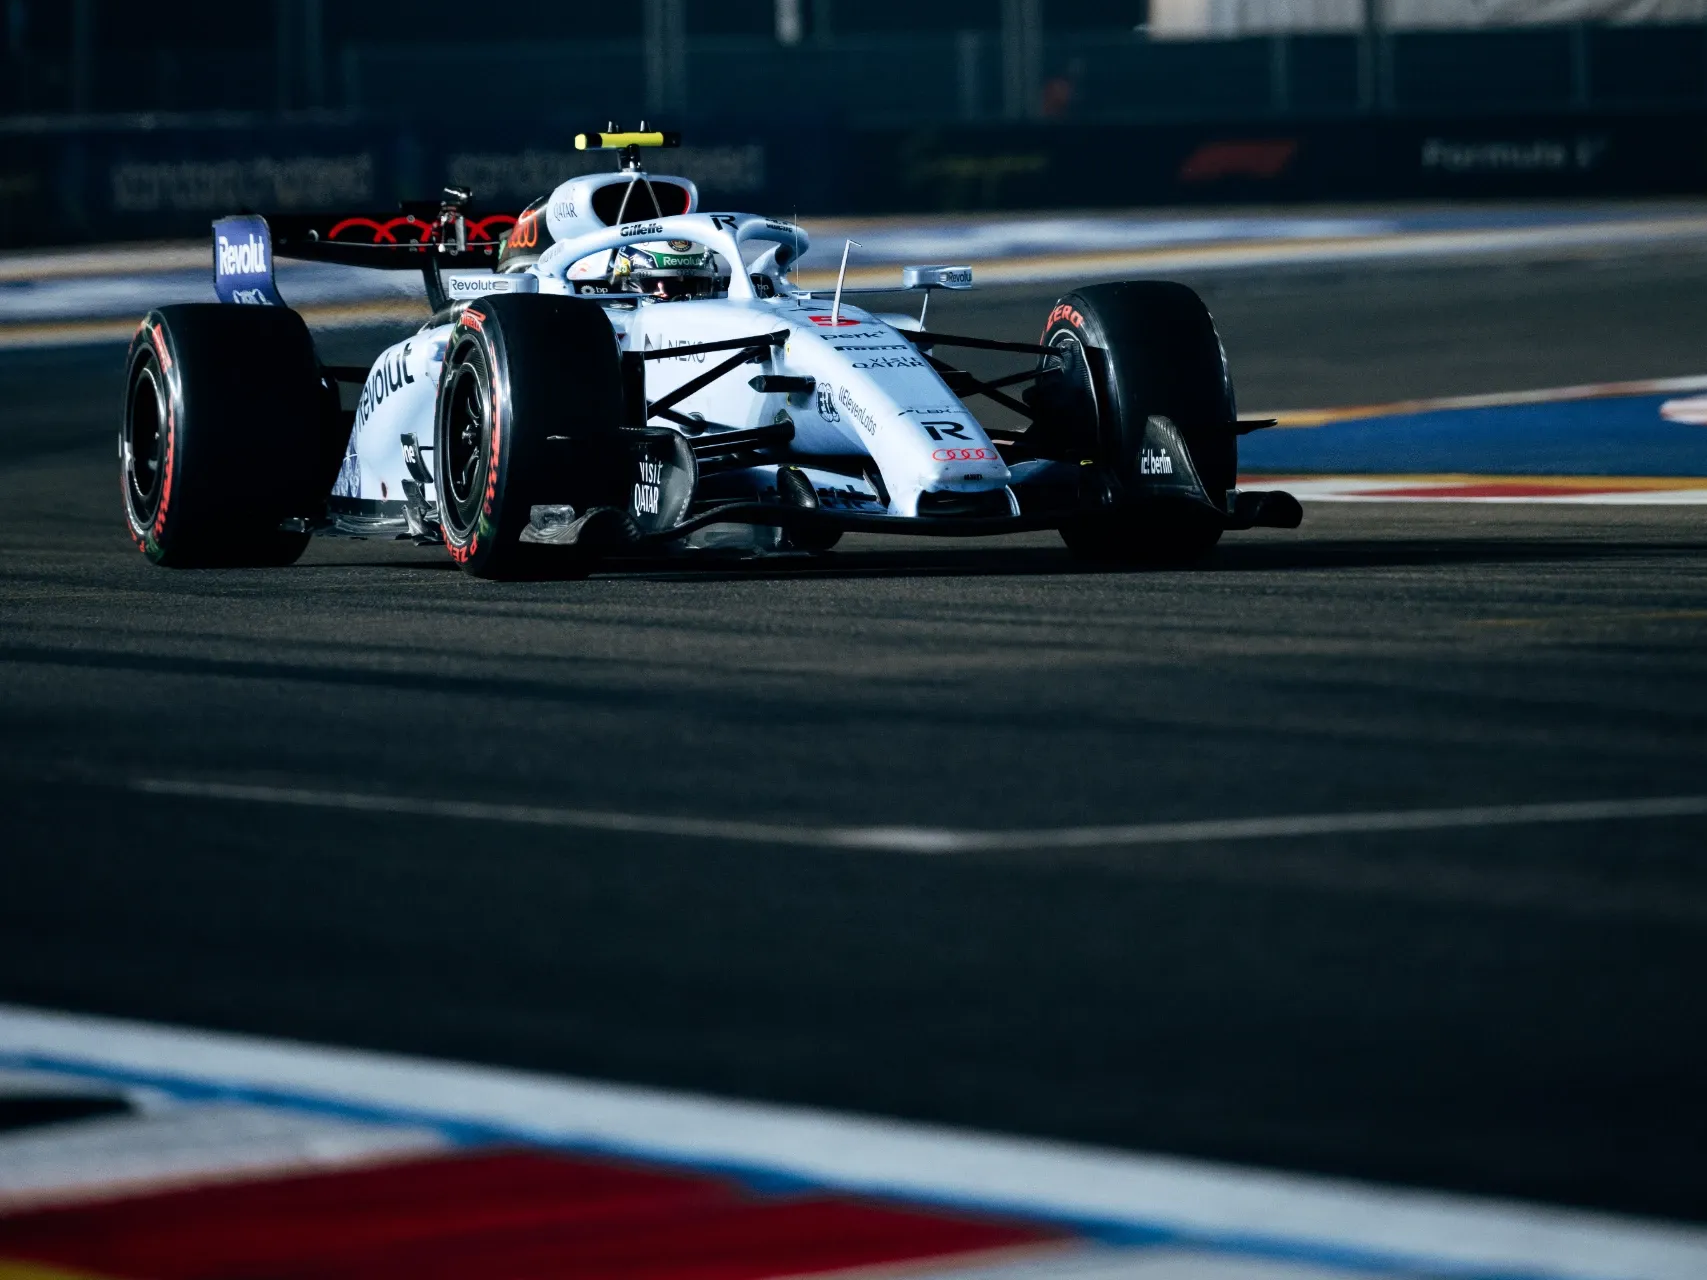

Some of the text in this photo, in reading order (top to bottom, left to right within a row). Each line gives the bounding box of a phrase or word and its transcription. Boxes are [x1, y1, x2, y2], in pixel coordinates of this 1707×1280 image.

[553, 202, 578, 222] QATAR
[620, 222, 664, 237] Gillette
[218, 233, 267, 276] Revolut
[451, 279, 494, 291] Revolut
[595, 286, 608, 294] bp
[852, 361, 926, 370] QATAR
[639, 453, 663, 485] visit
[634, 483, 660, 517] QATAR
